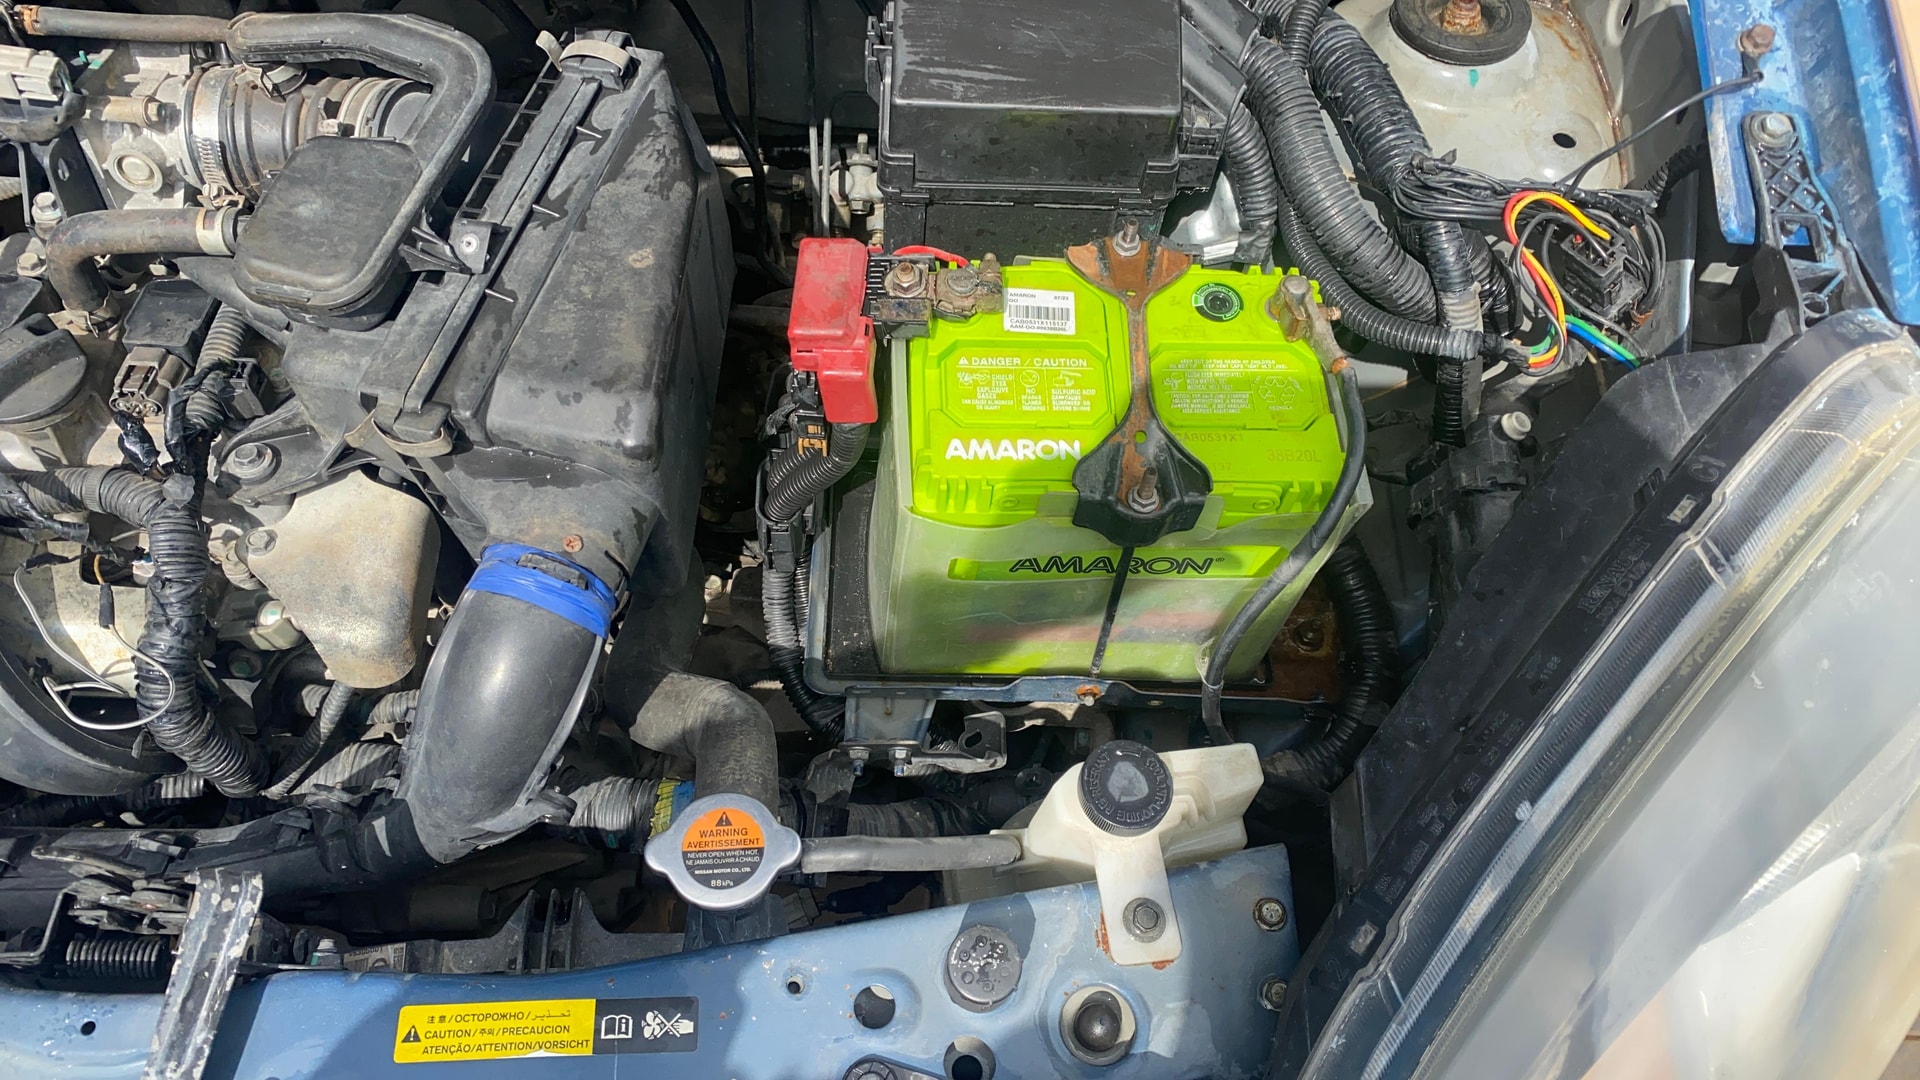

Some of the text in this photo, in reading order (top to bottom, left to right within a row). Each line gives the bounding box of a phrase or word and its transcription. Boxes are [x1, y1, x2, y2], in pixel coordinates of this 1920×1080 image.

[971, 356, 1021, 367] DANGER
[1033, 357, 1087, 368] CAUTION
[944, 437, 1083, 461] AMARON
[1267, 449, 1323, 463] 38B20L
[699, 827, 748, 839] WARNING
[686, 838, 761, 849] AVERTISSEMENT
[687, 851, 707, 859] NEVER
[708, 850, 725, 858] OPEN
[726, 849, 745, 857] WHEN
